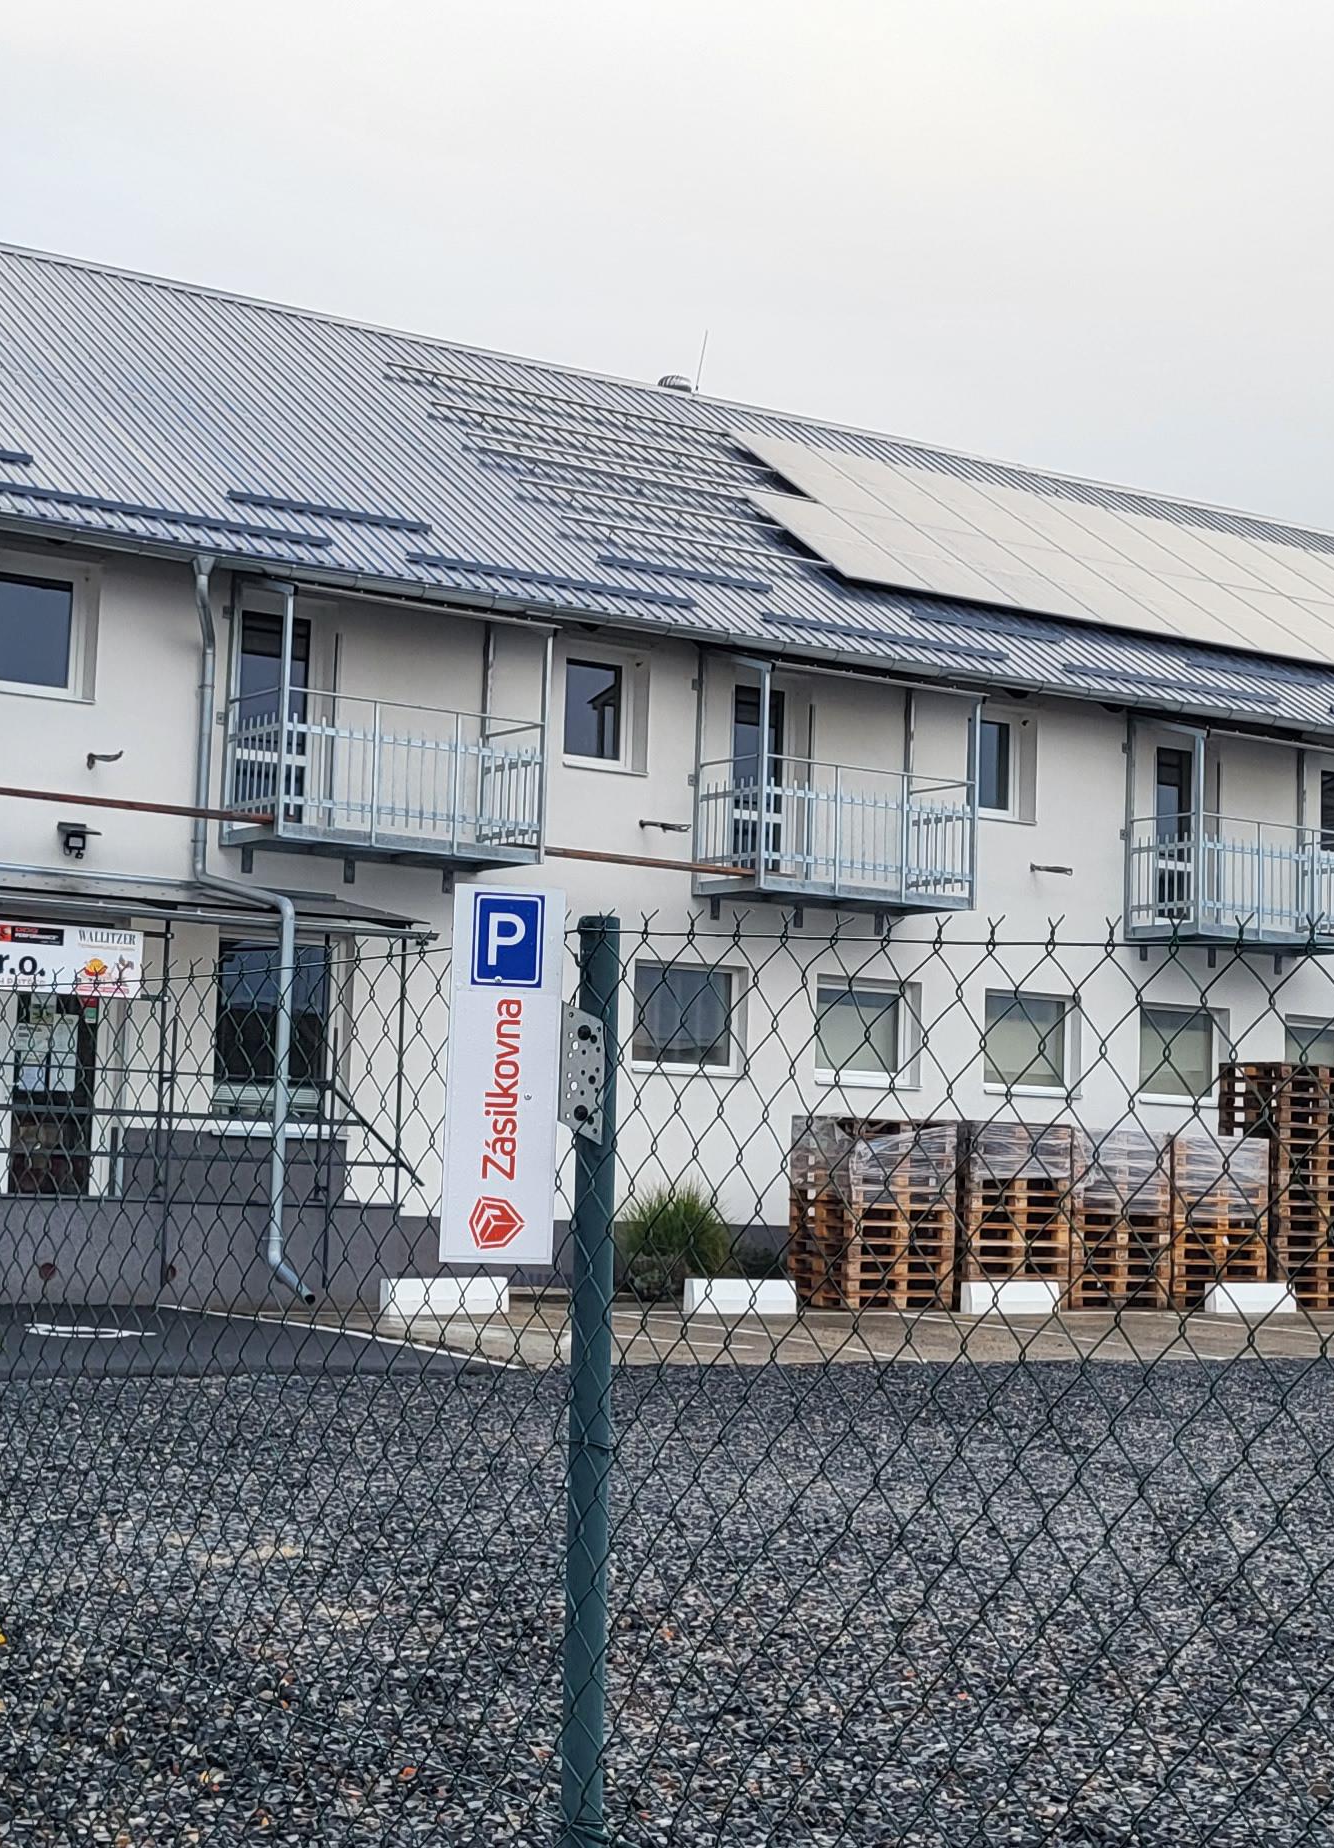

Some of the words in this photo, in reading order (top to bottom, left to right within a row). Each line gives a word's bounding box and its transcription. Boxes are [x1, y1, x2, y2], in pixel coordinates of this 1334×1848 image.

[78, 929, 136, 946] WALLITZER
[487, 912, 526, 966] P
[481, 998, 523, 1181] Zásilkovna
